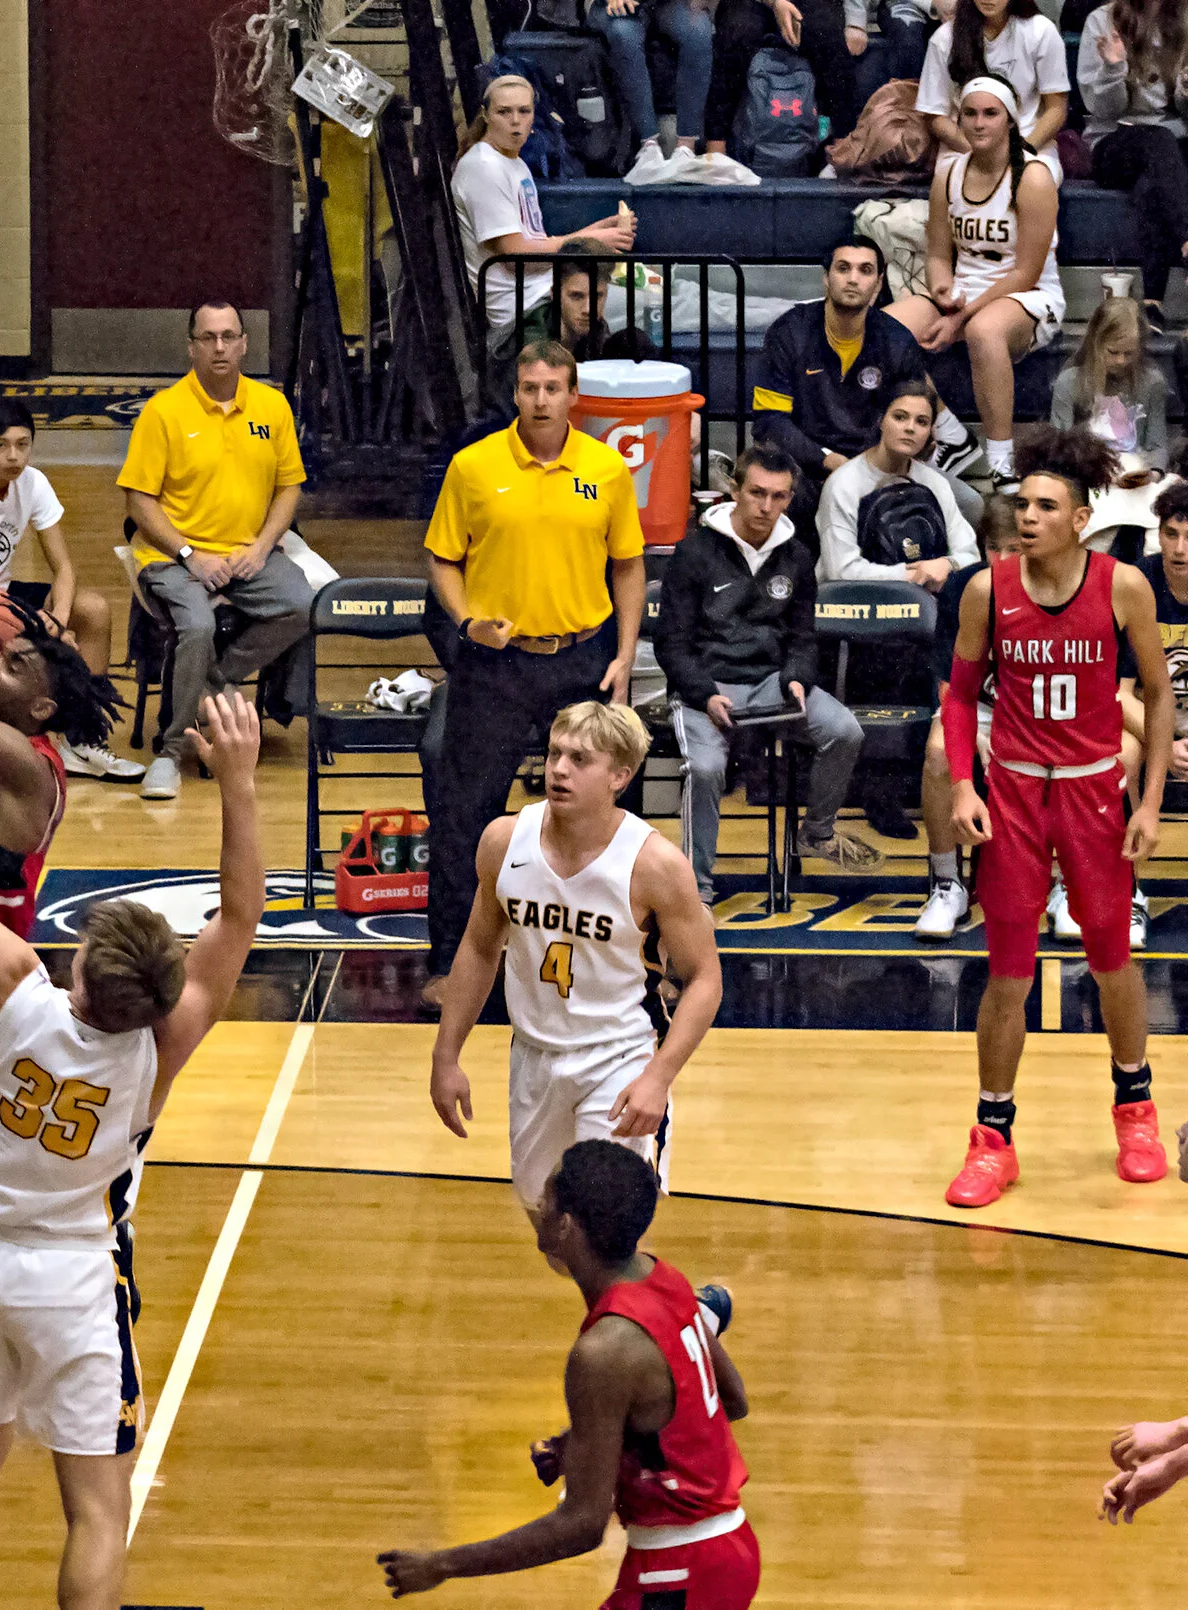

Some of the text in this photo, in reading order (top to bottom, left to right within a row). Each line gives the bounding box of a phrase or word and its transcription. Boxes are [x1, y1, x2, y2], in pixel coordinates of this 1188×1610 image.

[950, 215, 1010, 242] AGLES
[248, 421, 270, 440] LN
[606, 424, 644, 468] G
[573, 477, 598, 500] LN
[332, 600, 427, 615] LIBERTY NORT
[814, 603, 921, 619] LIBERTY NORTH
[1001, 639, 1105, 664] PARK HILL
[1031, 673, 1077, 721] 10
[380, 847, 397, 866] G
[413, 844, 430, 864] G
[507, 897, 614, 942] EAGLES
[539, 941, 574, 999] 4
